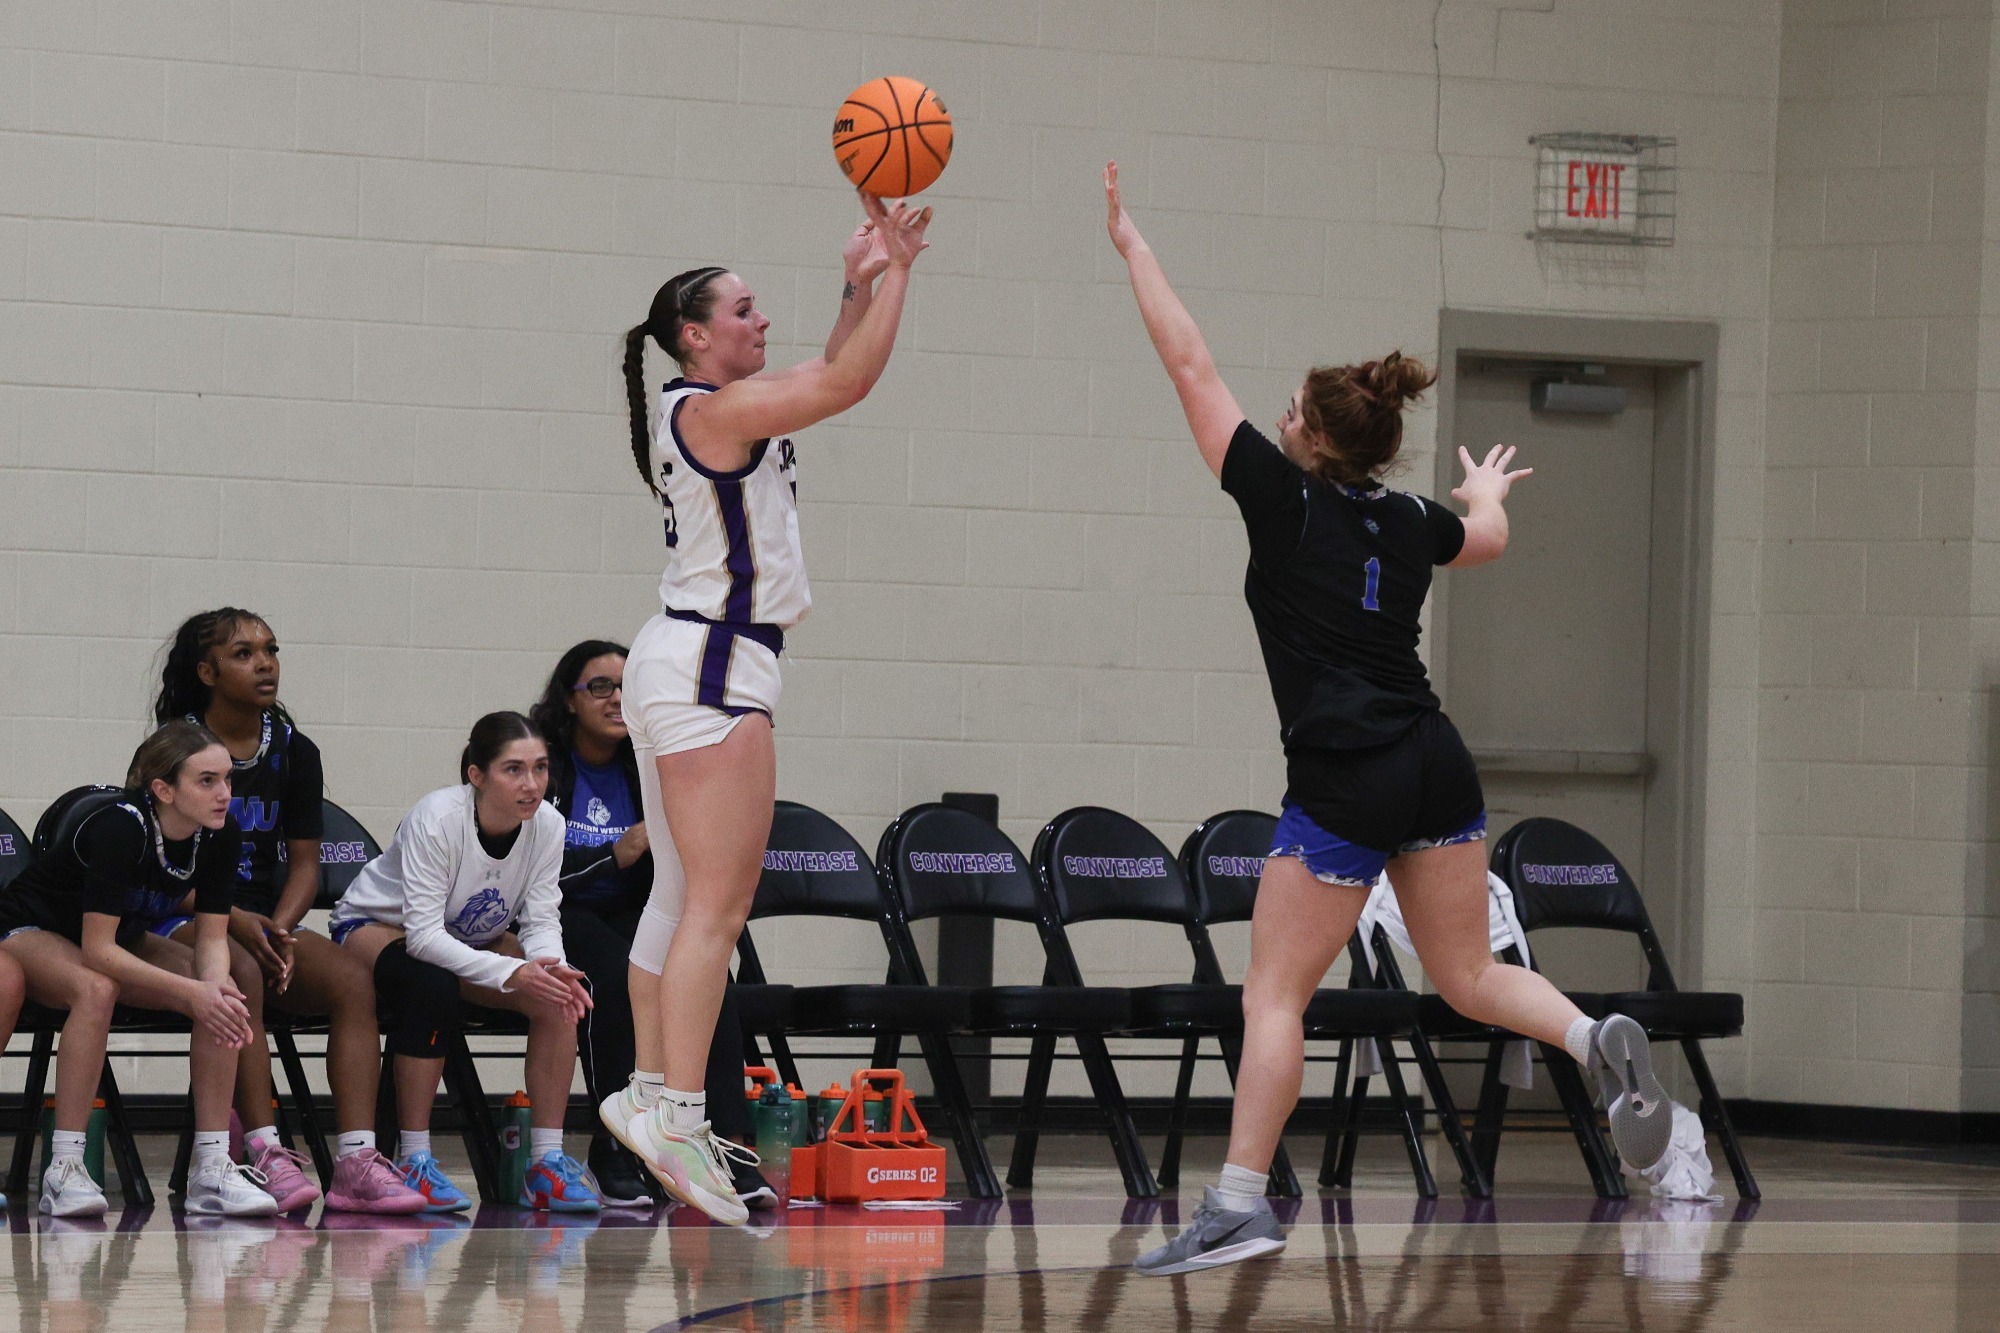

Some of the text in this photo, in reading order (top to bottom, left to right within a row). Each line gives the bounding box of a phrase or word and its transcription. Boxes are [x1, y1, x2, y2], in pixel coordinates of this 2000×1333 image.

[1567, 161, 1626, 219] EXIT
[1361, 557, 1381, 611] 1
[228, 796, 279, 832] WU
[763, 851, 859, 871] ONVERSE
[910, 852, 1016, 873] CONVERSE
[1064, 856, 1167, 878] CONVERSE
[1209, 856, 1266, 877] CONV
[1523, 864, 1618, 885] CONVERSE
[920, 1167, 937, 1183] 02
